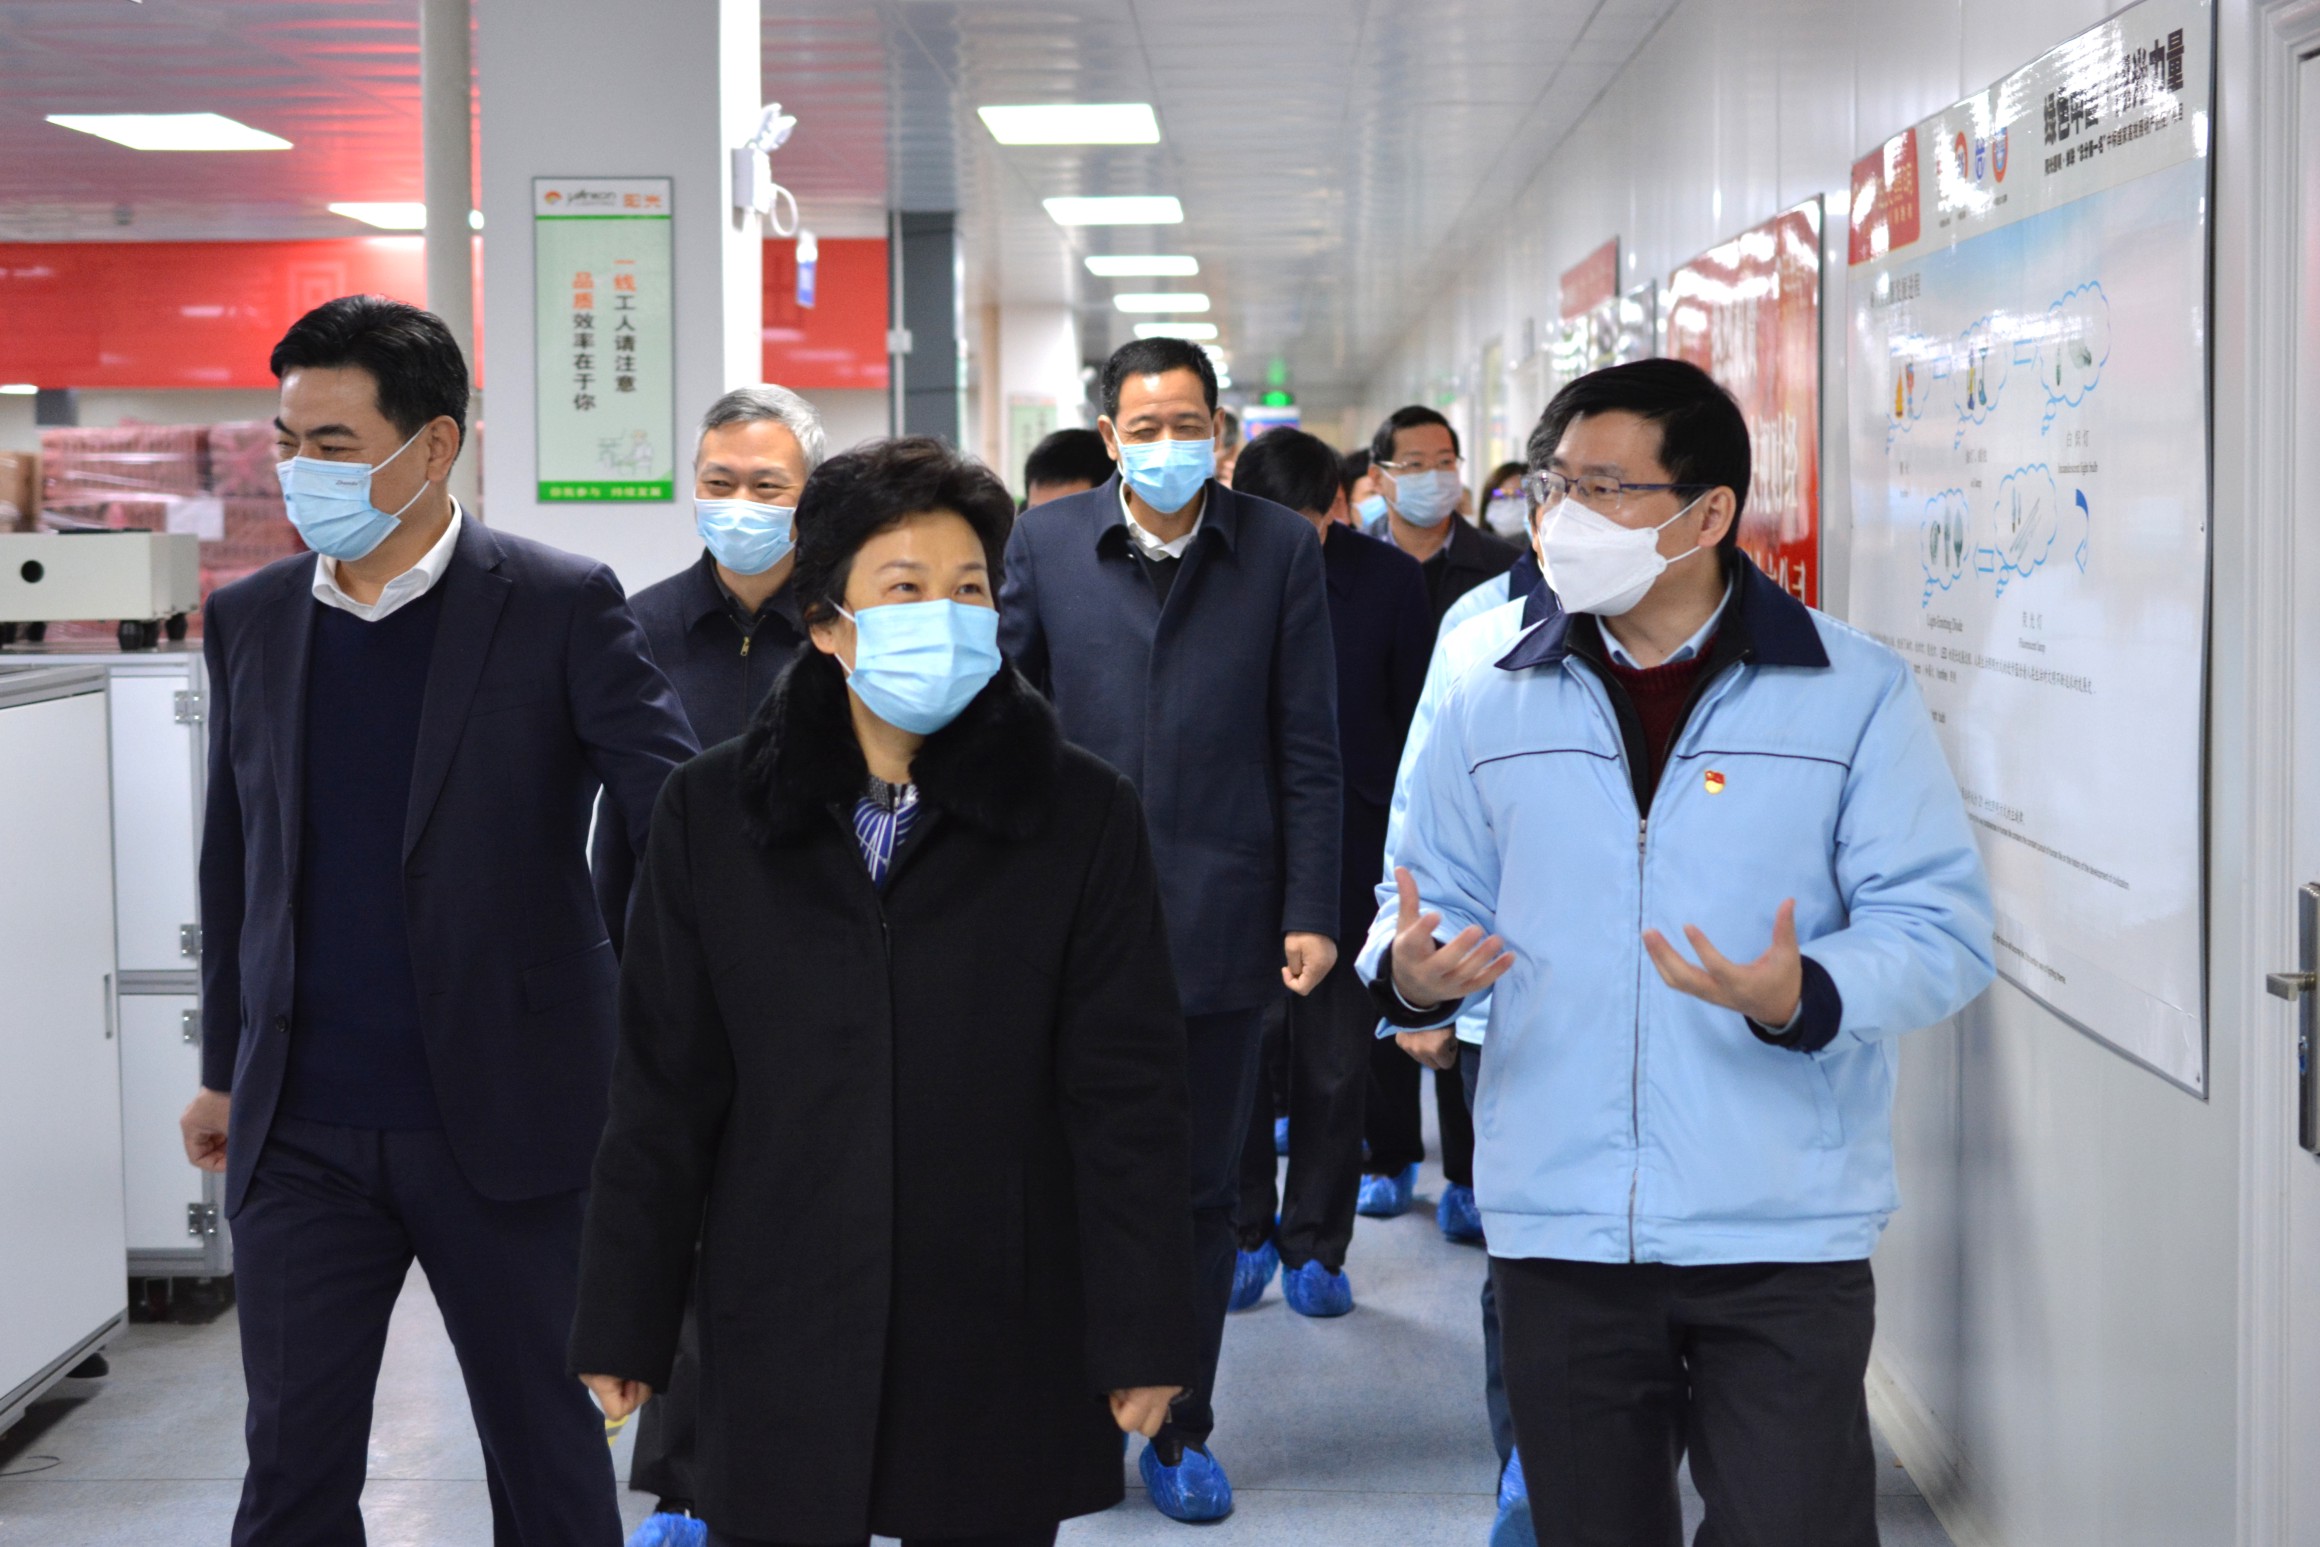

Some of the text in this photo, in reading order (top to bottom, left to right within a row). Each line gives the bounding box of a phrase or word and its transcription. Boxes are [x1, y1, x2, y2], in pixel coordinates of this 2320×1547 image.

[571, 271, 596, 411] 品质效率在于你
[613, 259, 637, 393] 一线工人请注意
